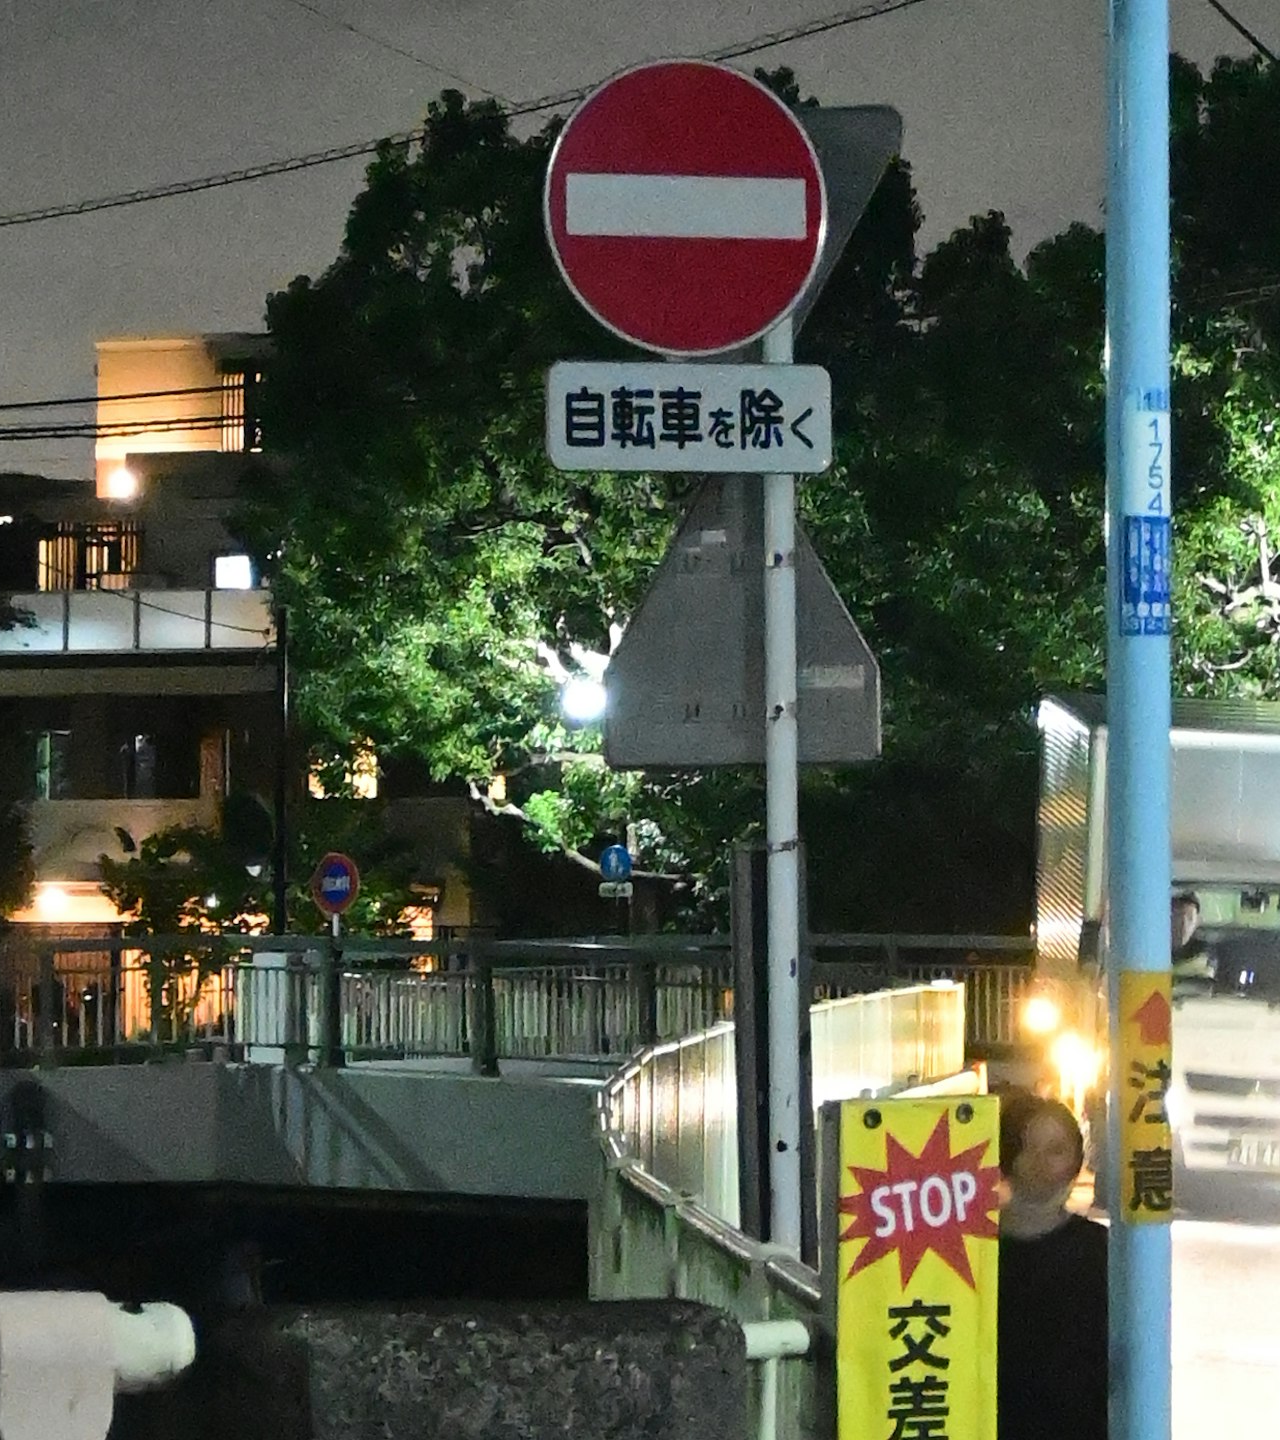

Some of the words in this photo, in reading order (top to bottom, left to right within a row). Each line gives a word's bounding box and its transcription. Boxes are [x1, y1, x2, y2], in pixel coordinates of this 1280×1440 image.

[565, 385, 814, 451] 自転車を除く
[870, 1170, 977, 1239] STOP
